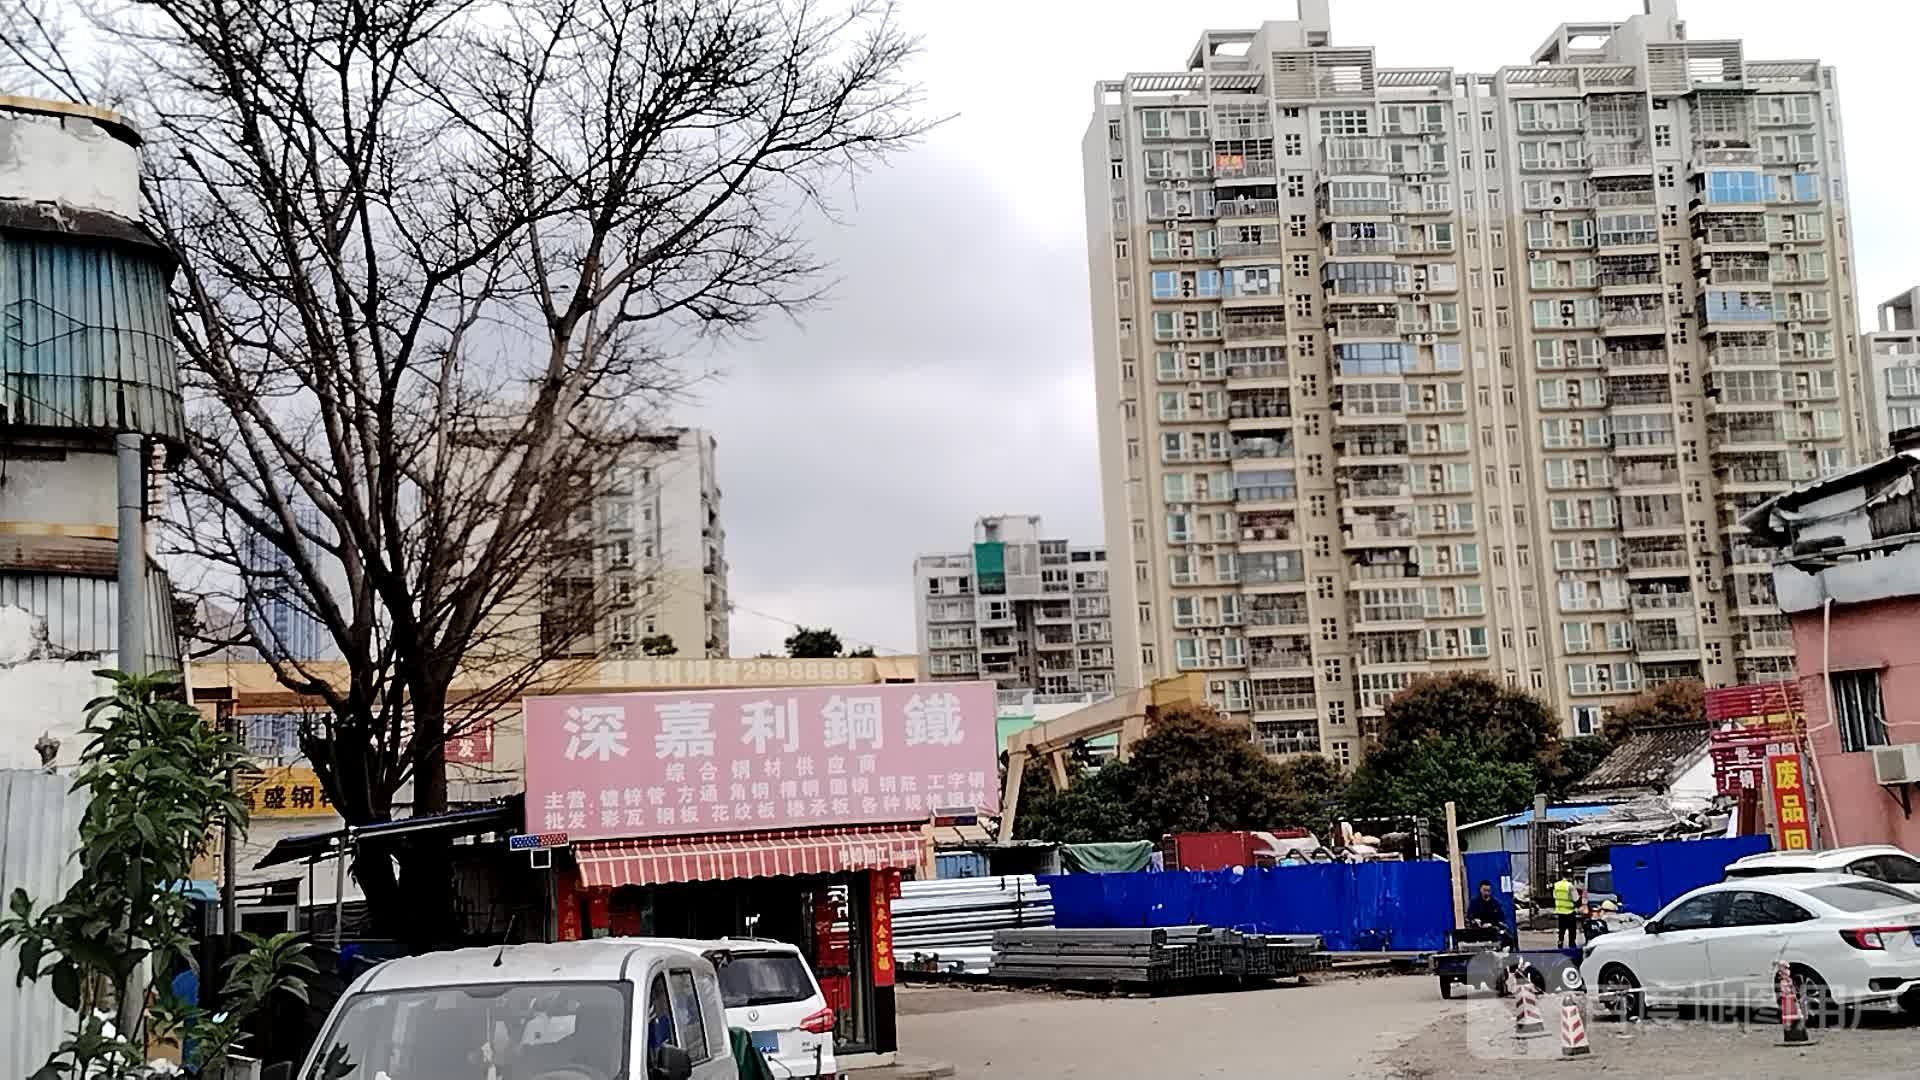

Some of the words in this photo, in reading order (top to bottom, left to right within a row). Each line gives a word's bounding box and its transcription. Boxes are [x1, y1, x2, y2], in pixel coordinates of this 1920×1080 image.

[563, 693, 965, 762] 深嘉利鋼鐵
[665, 754, 876, 783] 综合钢材供应商
[1774, 759, 1809, 850] 废品回
